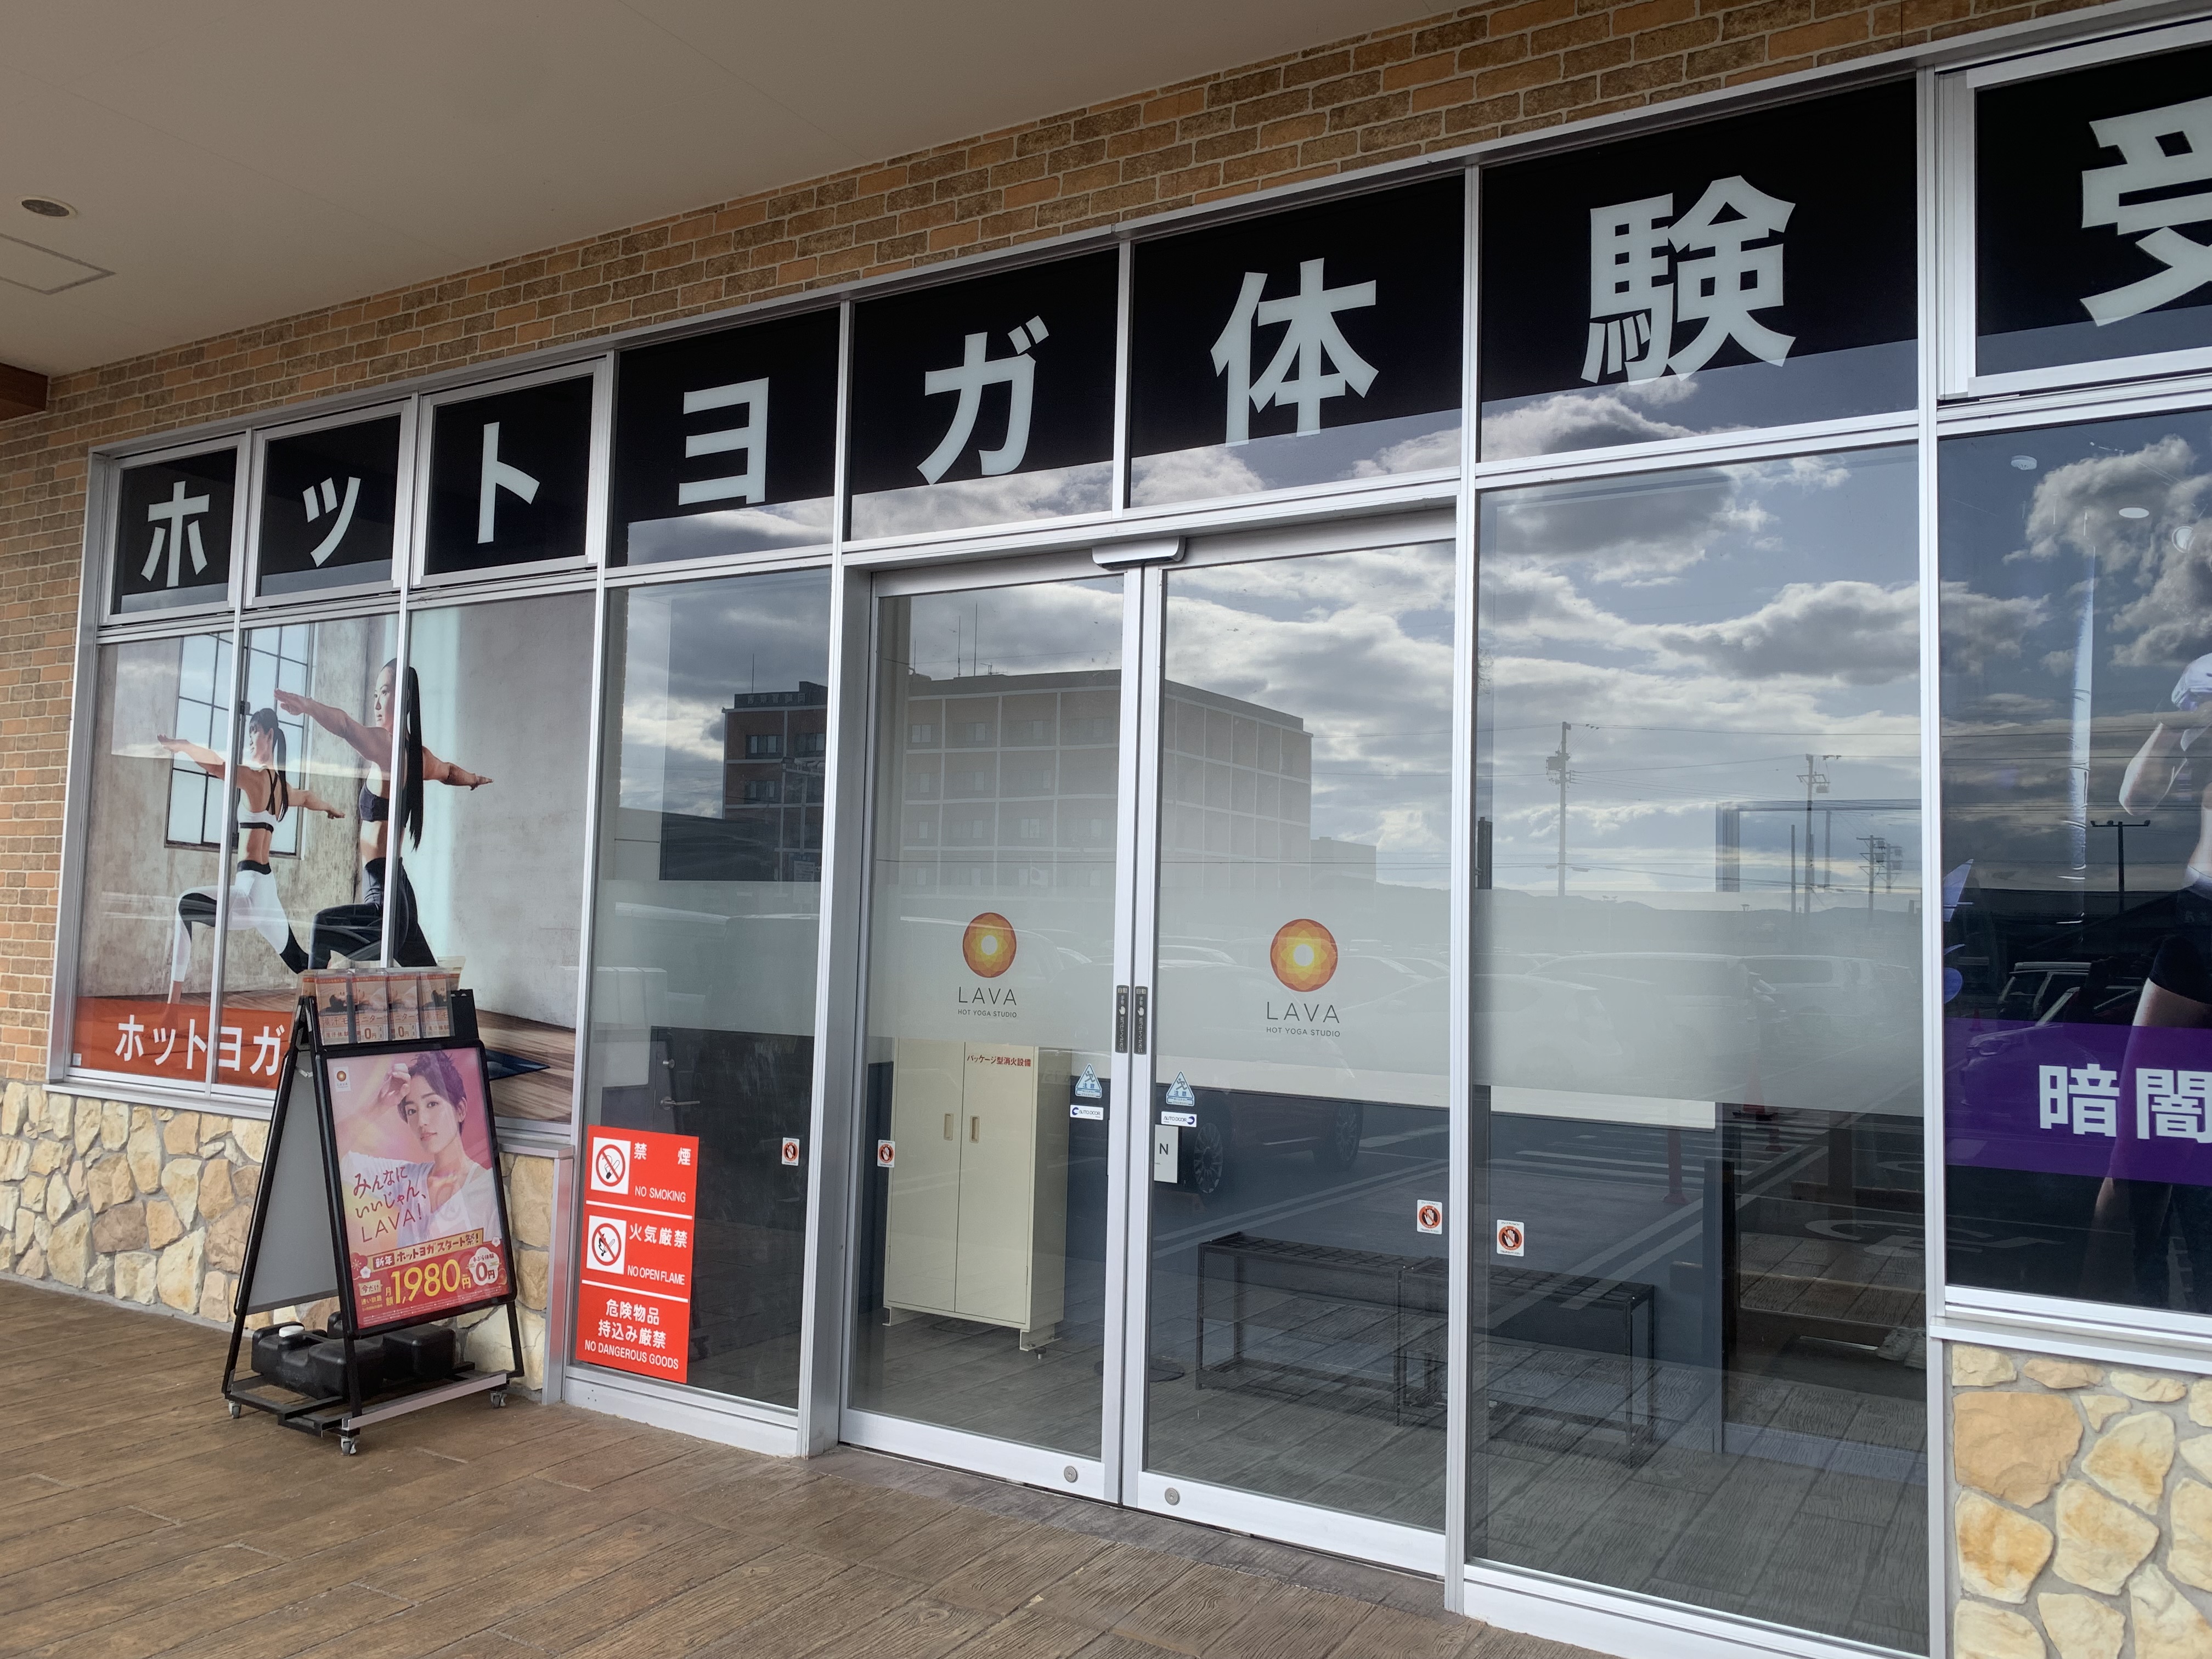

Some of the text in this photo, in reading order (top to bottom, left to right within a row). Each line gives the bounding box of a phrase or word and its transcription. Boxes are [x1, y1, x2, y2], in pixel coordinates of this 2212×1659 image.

[958, 986, 1017, 1006] LAVA
[1267, 1001, 1340, 1024] LAVA
[115, 1014, 285, 1076] ホットヨガ
[1310, 1029, 1340, 1037] STUDIO
[967, 1054, 1031, 1067] パッケージ型消火設備
[2039, 1063, 2212, 1144] 暗闇
[353, 1166, 408, 1199] みんなに
[635, 1186, 686, 1203] NO SMOKING
[356, 1180, 427, 1219] いいじゃん、
[361, 1204, 423, 1243] LAVA!
[629, 1223, 687, 1248] 火気厳禁
[375, 1255, 393, 1268] 新年
[476, 1262, 495, 1282] 0円
[627, 1265, 685, 1285] NO OPEN FLAME
[361, 1284, 379, 1294] 今だけ
[606, 1299, 660, 1325] 危険物品
[598, 1319, 667, 1349] 持込み厳禁
[585, 1339, 679, 1370] NO DANGEROUS GOODS
